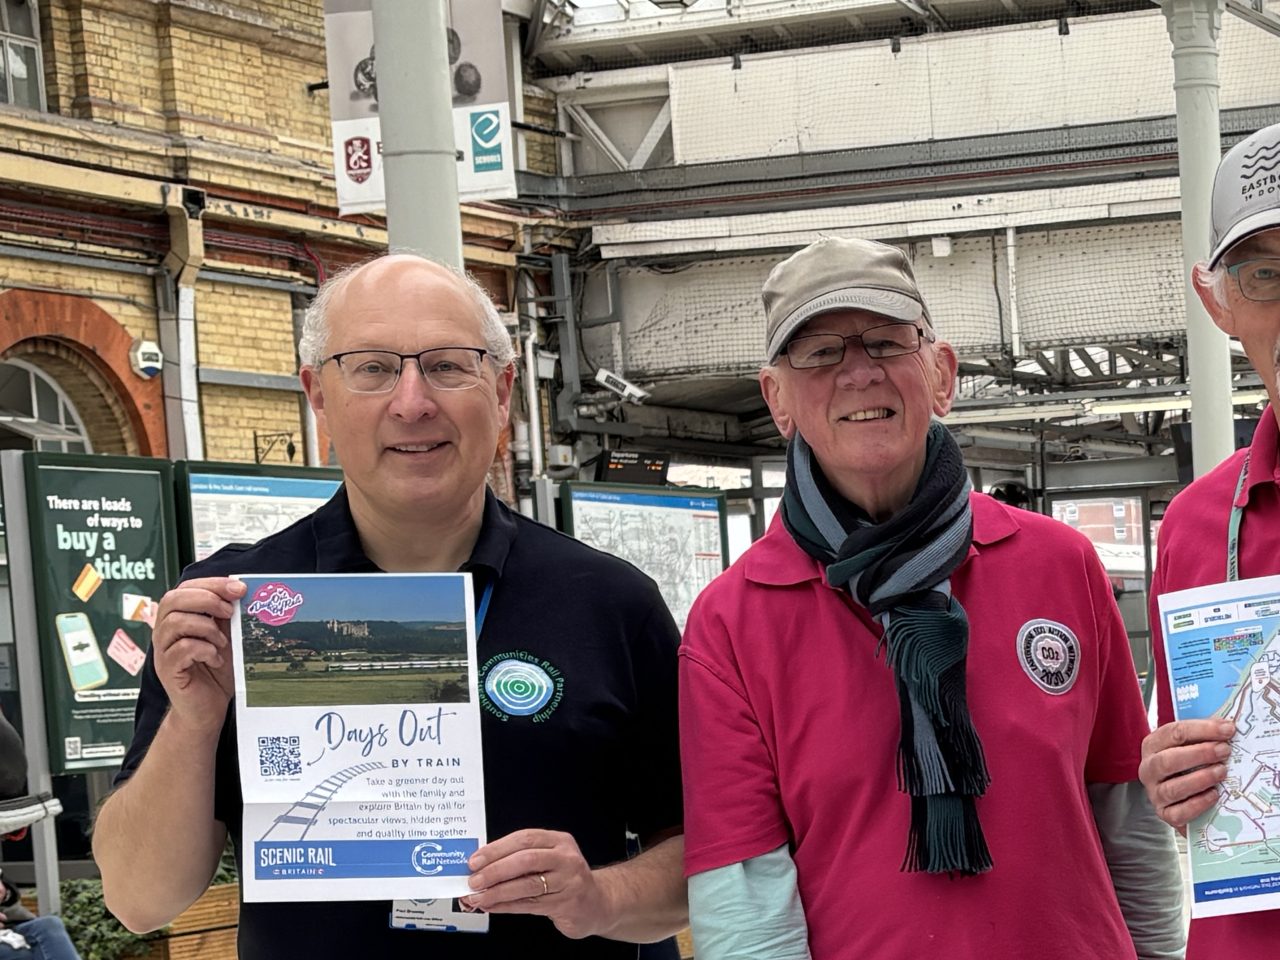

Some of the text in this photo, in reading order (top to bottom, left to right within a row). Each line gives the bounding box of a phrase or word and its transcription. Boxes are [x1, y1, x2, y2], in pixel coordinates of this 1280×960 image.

[47, 495, 131, 512] There are loads
[87, 515, 142, 531] of ways to
[56, 524, 115, 557] buy a
[95, 556, 155, 580] ticket
[541, 661, 561, 676] Rail
[1040, 669, 1065, 686] 2030
[315, 707, 457, 757] Days Out
[391, 757, 461, 768] BY TRAIN
[366, 778, 385, 787] Take
[395, 778, 429, 788] greener
[431, 776, 447, 786] day
[450, 776, 465, 784] out
[382, 789, 465, 799] with the family and
[359, 801, 465, 812] explore Britain by rail for
[328, 816, 379, 826] spectacular
[410, 815, 441, 824] hidden
[443, 816, 467, 825] gems
[356, 828, 467, 839] and quality time together
[260, 847, 337, 867] SCENIC RAIL
[421, 850, 465, 860] Community
[421, 857, 469, 866] Rail Network
[282, 868, 317, 876] BRITAIN
